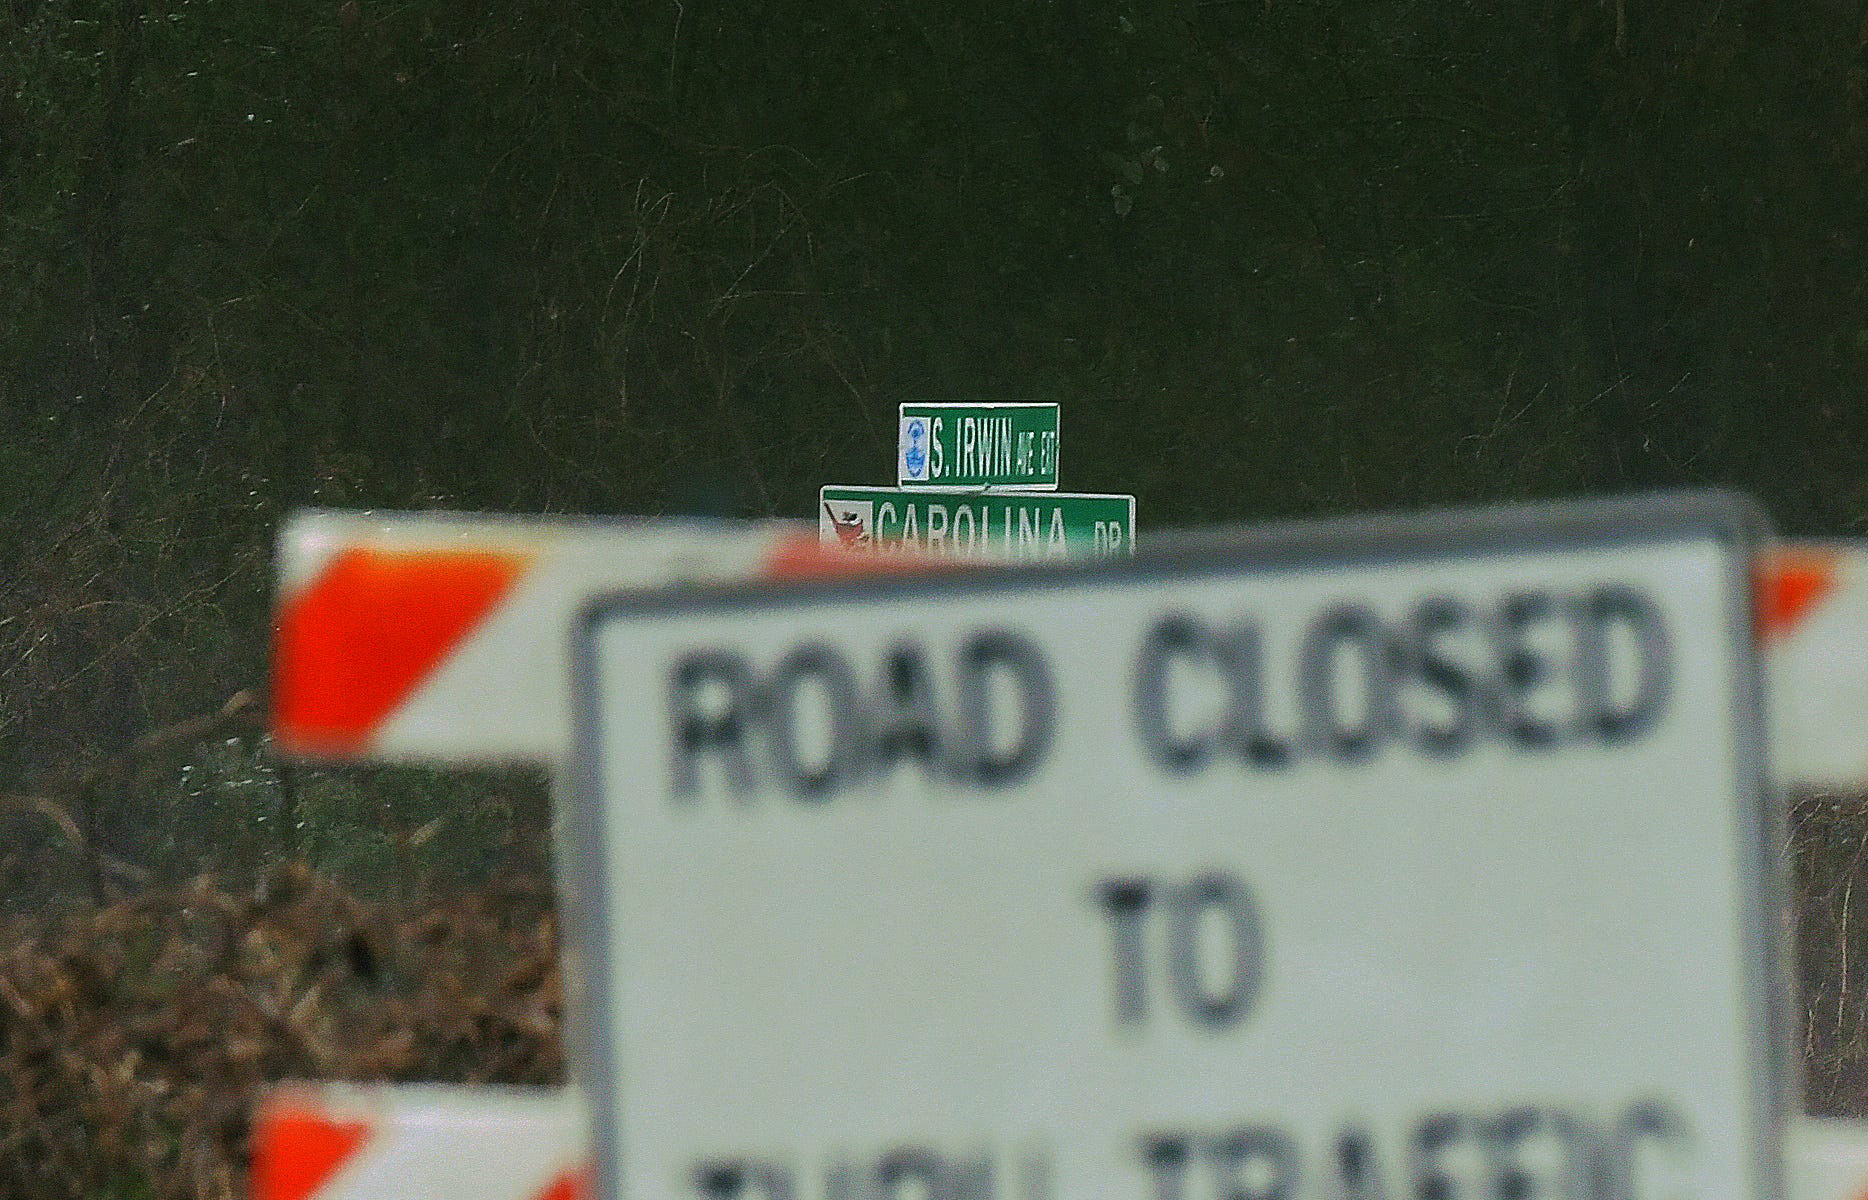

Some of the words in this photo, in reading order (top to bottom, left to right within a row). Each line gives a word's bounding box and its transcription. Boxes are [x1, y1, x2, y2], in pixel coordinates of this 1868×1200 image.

[931, 417, 949, 477] S.
[956, 417, 1012, 476] IRWIN
[1015, 431, 1034, 475] AVE
[877, 502, 1066, 558] CAROLINA
[1094, 521, 1122, 555] DR
[668, 628, 1056, 803] ROAD
[1134, 585, 1669, 775] CLOSED
[1093, 874, 1260, 1029] TO
